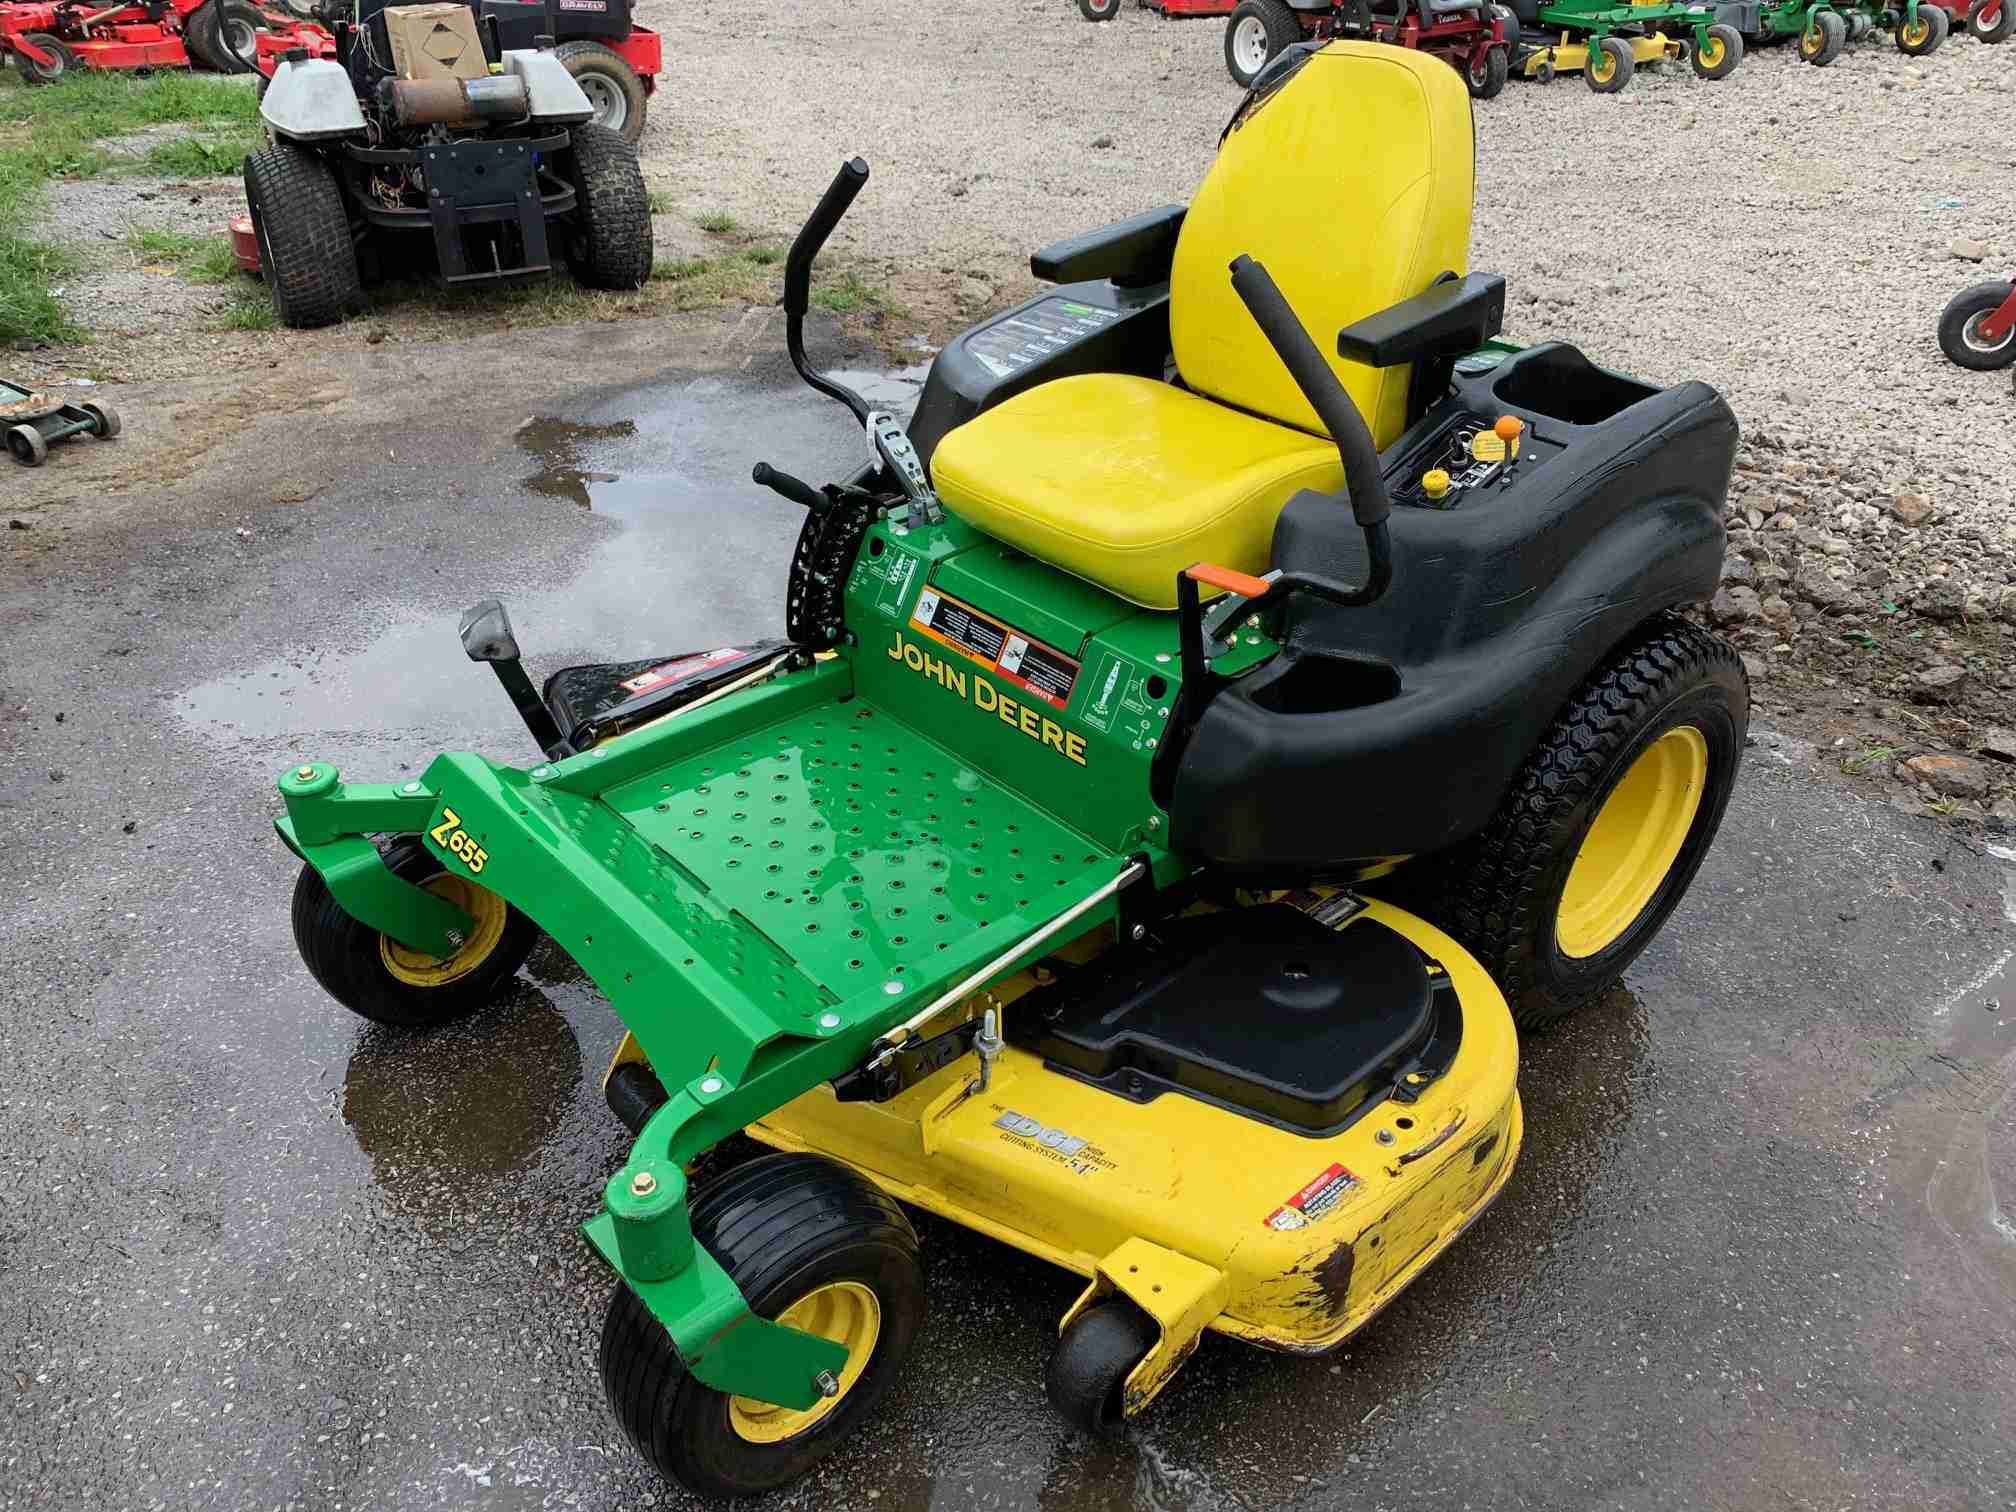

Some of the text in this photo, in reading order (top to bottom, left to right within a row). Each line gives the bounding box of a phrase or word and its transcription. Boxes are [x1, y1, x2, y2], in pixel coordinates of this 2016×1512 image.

[561, 0, 607, 10] GRAVELY
[888, 631, 967, 700] JOHN
[974, 674, 1088, 767] DEERE
[430, 807, 489, 873] Z655
